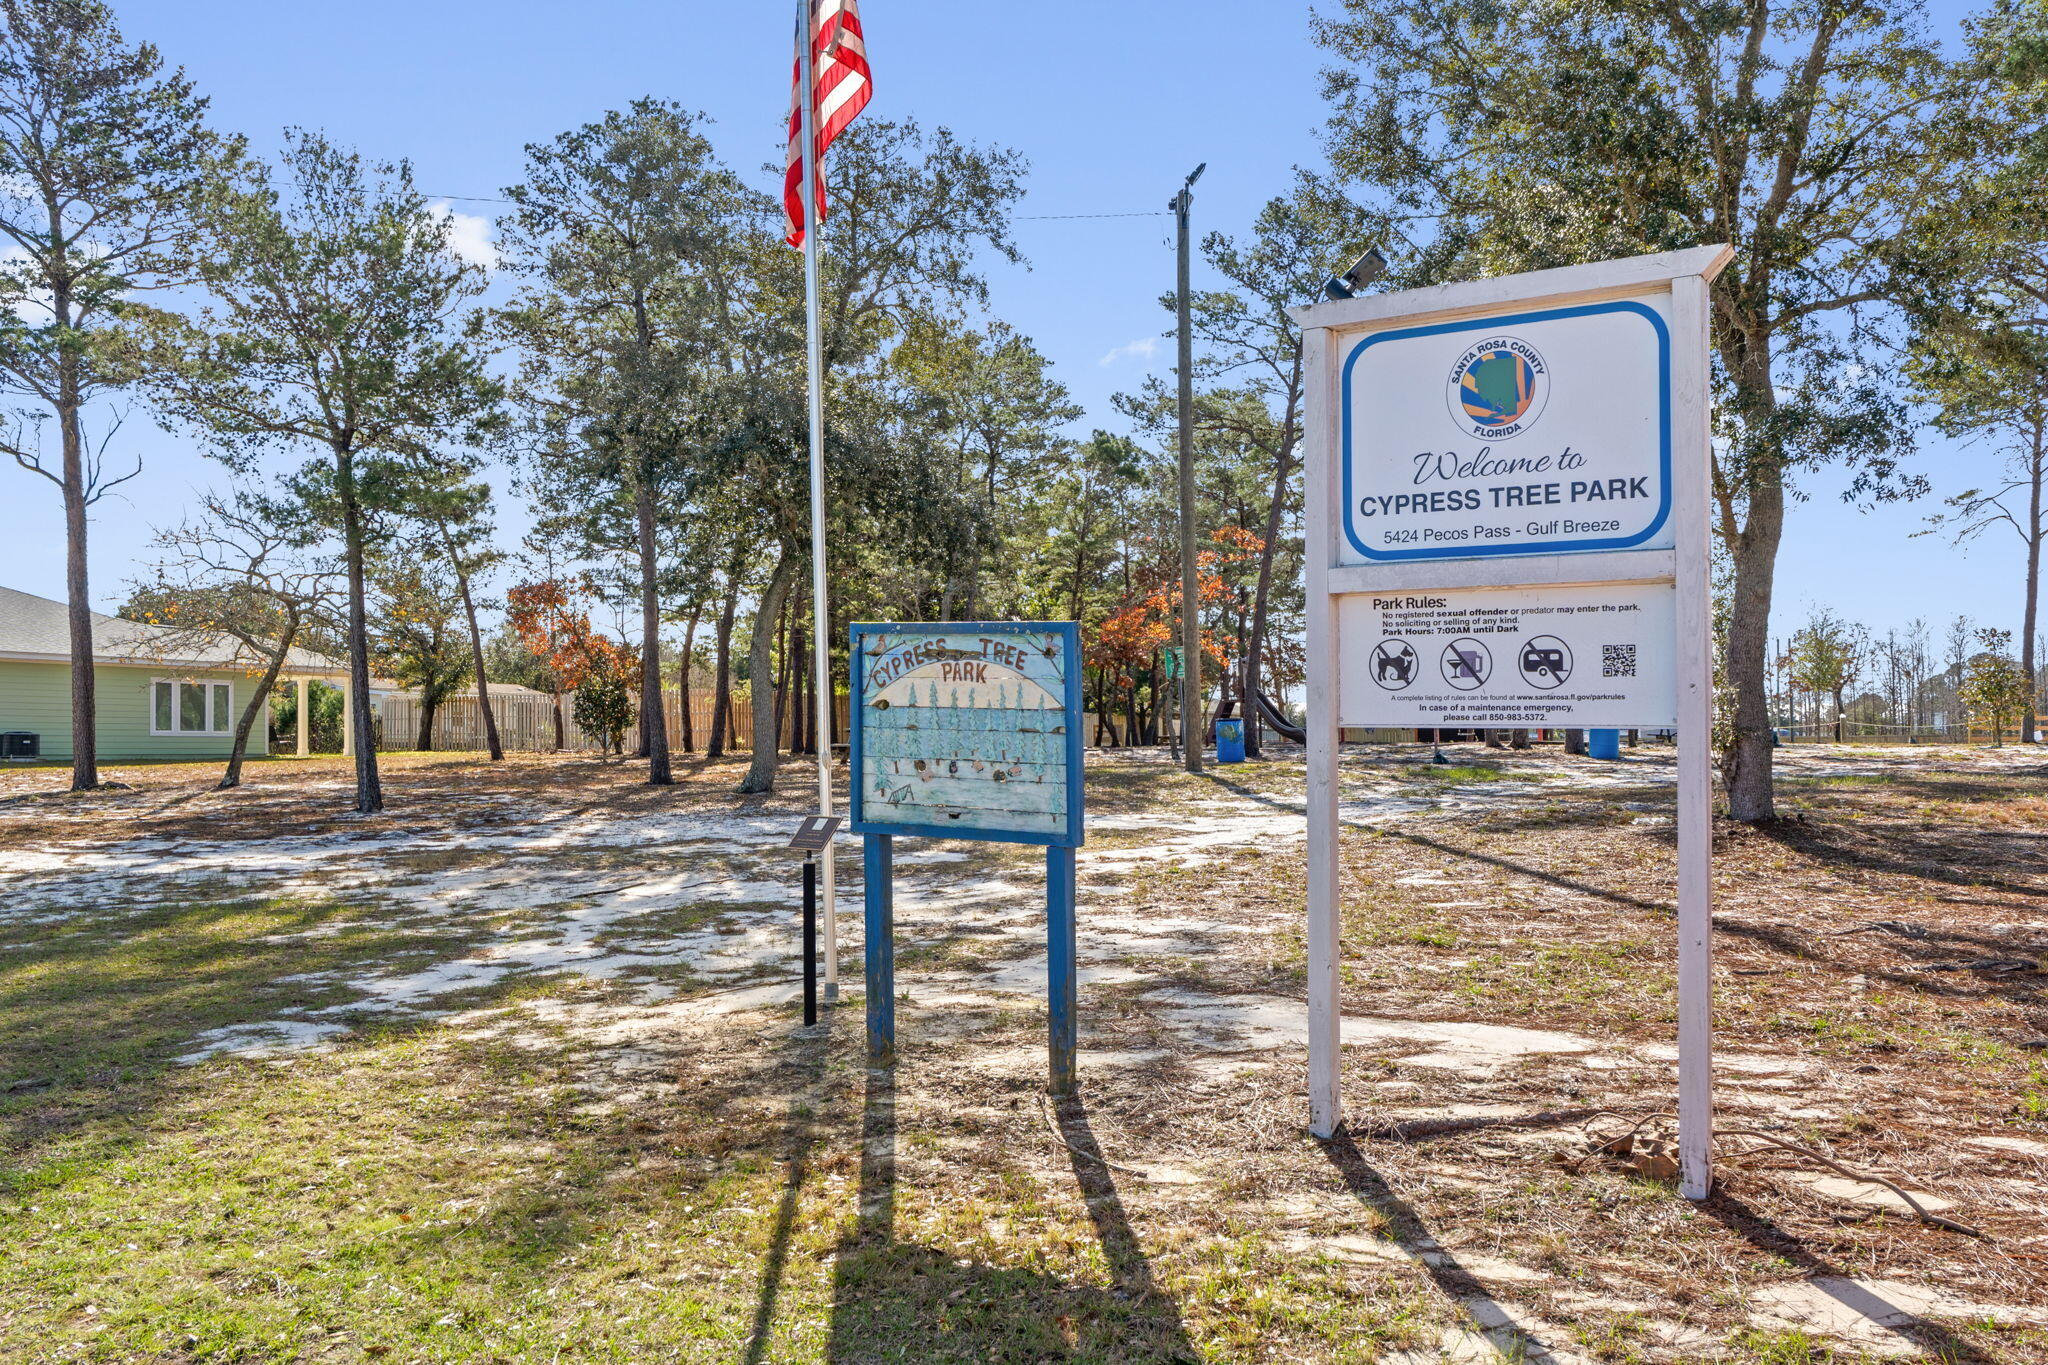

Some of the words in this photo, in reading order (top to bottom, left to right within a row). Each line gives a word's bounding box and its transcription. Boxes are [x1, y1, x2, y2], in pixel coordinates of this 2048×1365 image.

[1452, 352, 1476, 384] SANTA
[1477, 340, 1507, 354] ROSA
[1510, 342, 1545, 374] COUNTY
[1473, 423, 1521, 437] FLORIDA
[1412, 446, 1553, 485] Welcome
[1555, 446, 1588, 472] to
[1360, 489, 1481, 516] CYPRESS
[1488, 483, 1561, 508] TREE
[1570, 476, 1649, 502] PARK
[1384, 529, 1418, 544] 5424
[1423, 526, 1469, 541] Pecos
[1474, 524, 1511, 539] Pass
[1527, 520, 1559, 536] Gulf
[1564, 518, 1620, 533] Breeze
[1373, 598, 1403, 610] Park
[1406, 596, 1447, 609] Rules:
[1395, 611, 1434, 620] registered
[1436, 609, 1466, 617] sexual
[1469, 608, 1508, 616] offender
[1521, 607, 1554, 616] predator
[1557, 607, 1575, 615] may
[1618, 603, 1641, 613] park.
[1395, 619, 1431, 628] soliciting
[1443, 618, 1470, 627] selling
[1482, 618, 1497, 626] any
[1500, 616, 1520, 624] kind.
[1382, 628, 1402, 636] Park
[1405, 627, 1435, 635] Hours:
[1437, 626, 1470, 635] 7:00AM
[1497, 625, 1519, 633] Dark
[873, 638, 947, 688] CYPRESS
[979, 638, 1028, 671] TREE
[941, 661, 988, 684] PARK
[1424, 694, 1442, 702] listing
[1468, 703, 1521, 711] maintenance
[1523, 704, 1574, 713] emergency,
[1443, 714, 1470, 722] please
[1472, 713, 1487, 721] call
[1489, 713, 1548, 721] 850-983-5372.
